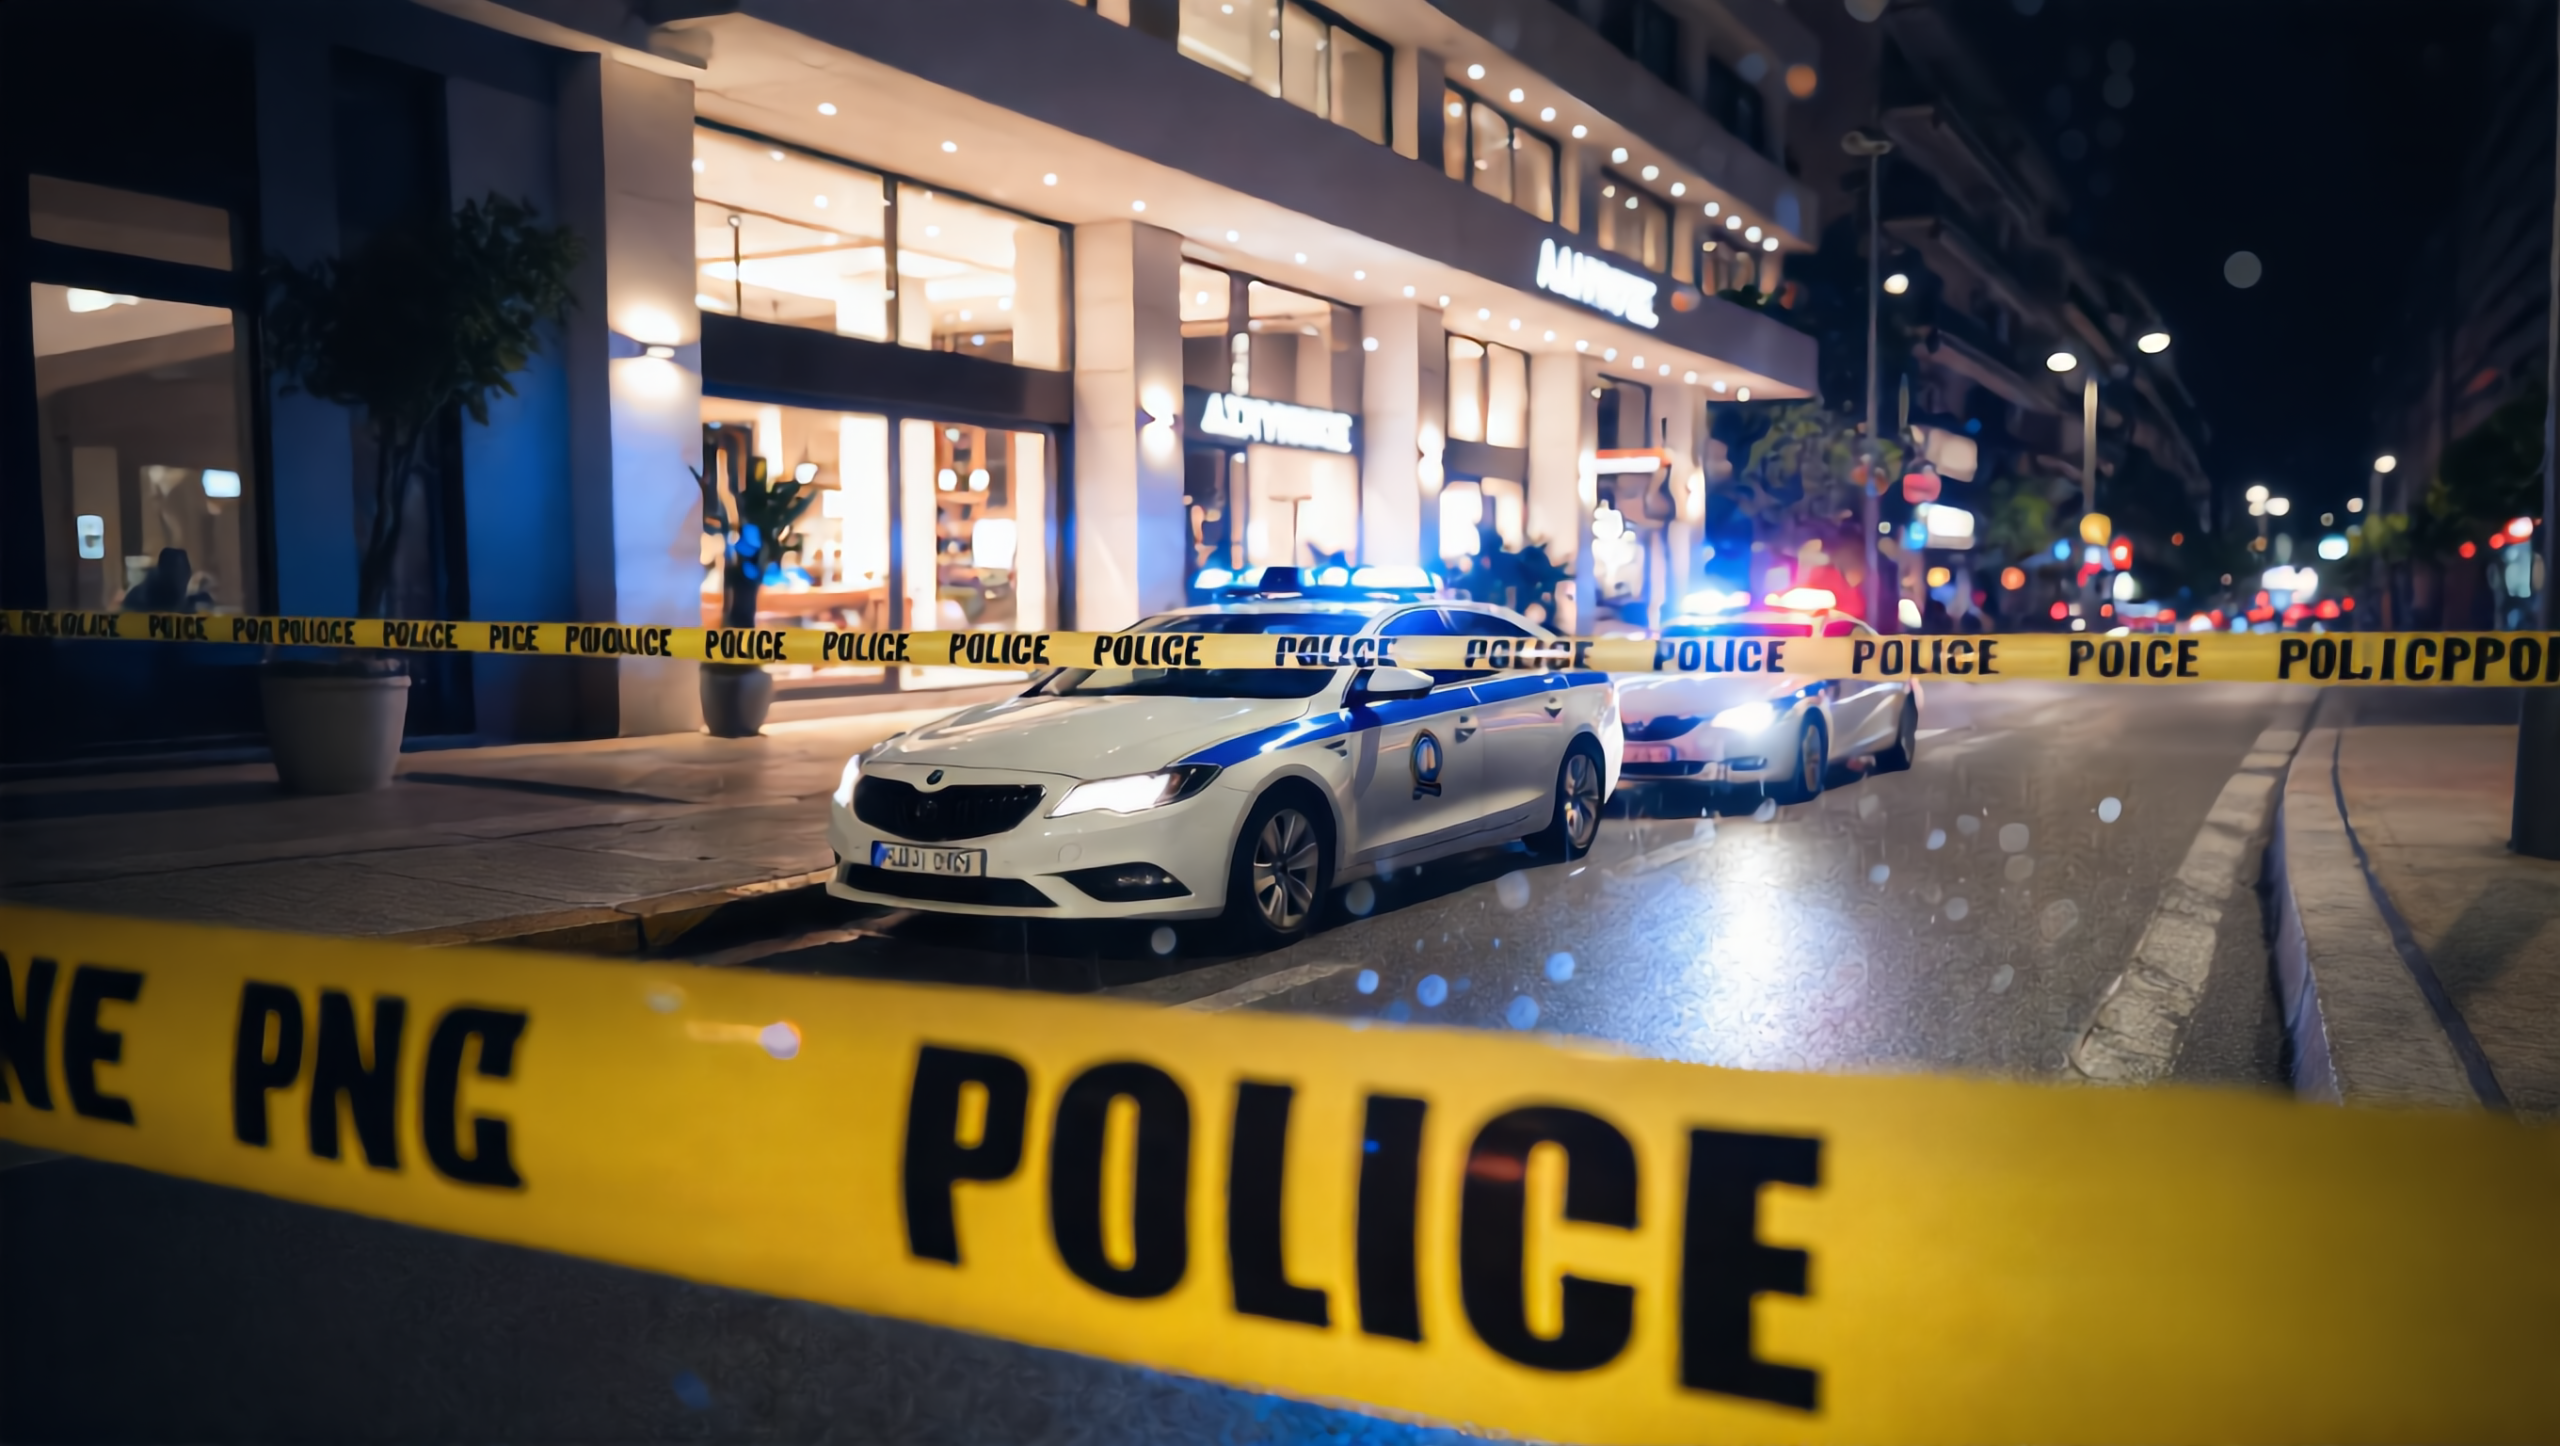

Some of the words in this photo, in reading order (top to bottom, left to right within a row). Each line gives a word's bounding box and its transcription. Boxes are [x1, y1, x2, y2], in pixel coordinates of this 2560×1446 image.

[705, 630, 787, 660] POLICE
[822, 632, 910, 662] POLICE
[950, 633, 1050, 665] POLICE
[1093, 635, 1204, 666] POLICE
[1275, 636, 1397, 667] POLICE
[1464, 639, 1594, 669] POLICE
[1652, 639, 1786, 672] POLICE
[1852, 639, 2000, 675] POLICE
[2068, 640, 2199, 677] POICE
[902, 1043, 1823, 1413] POLICE
